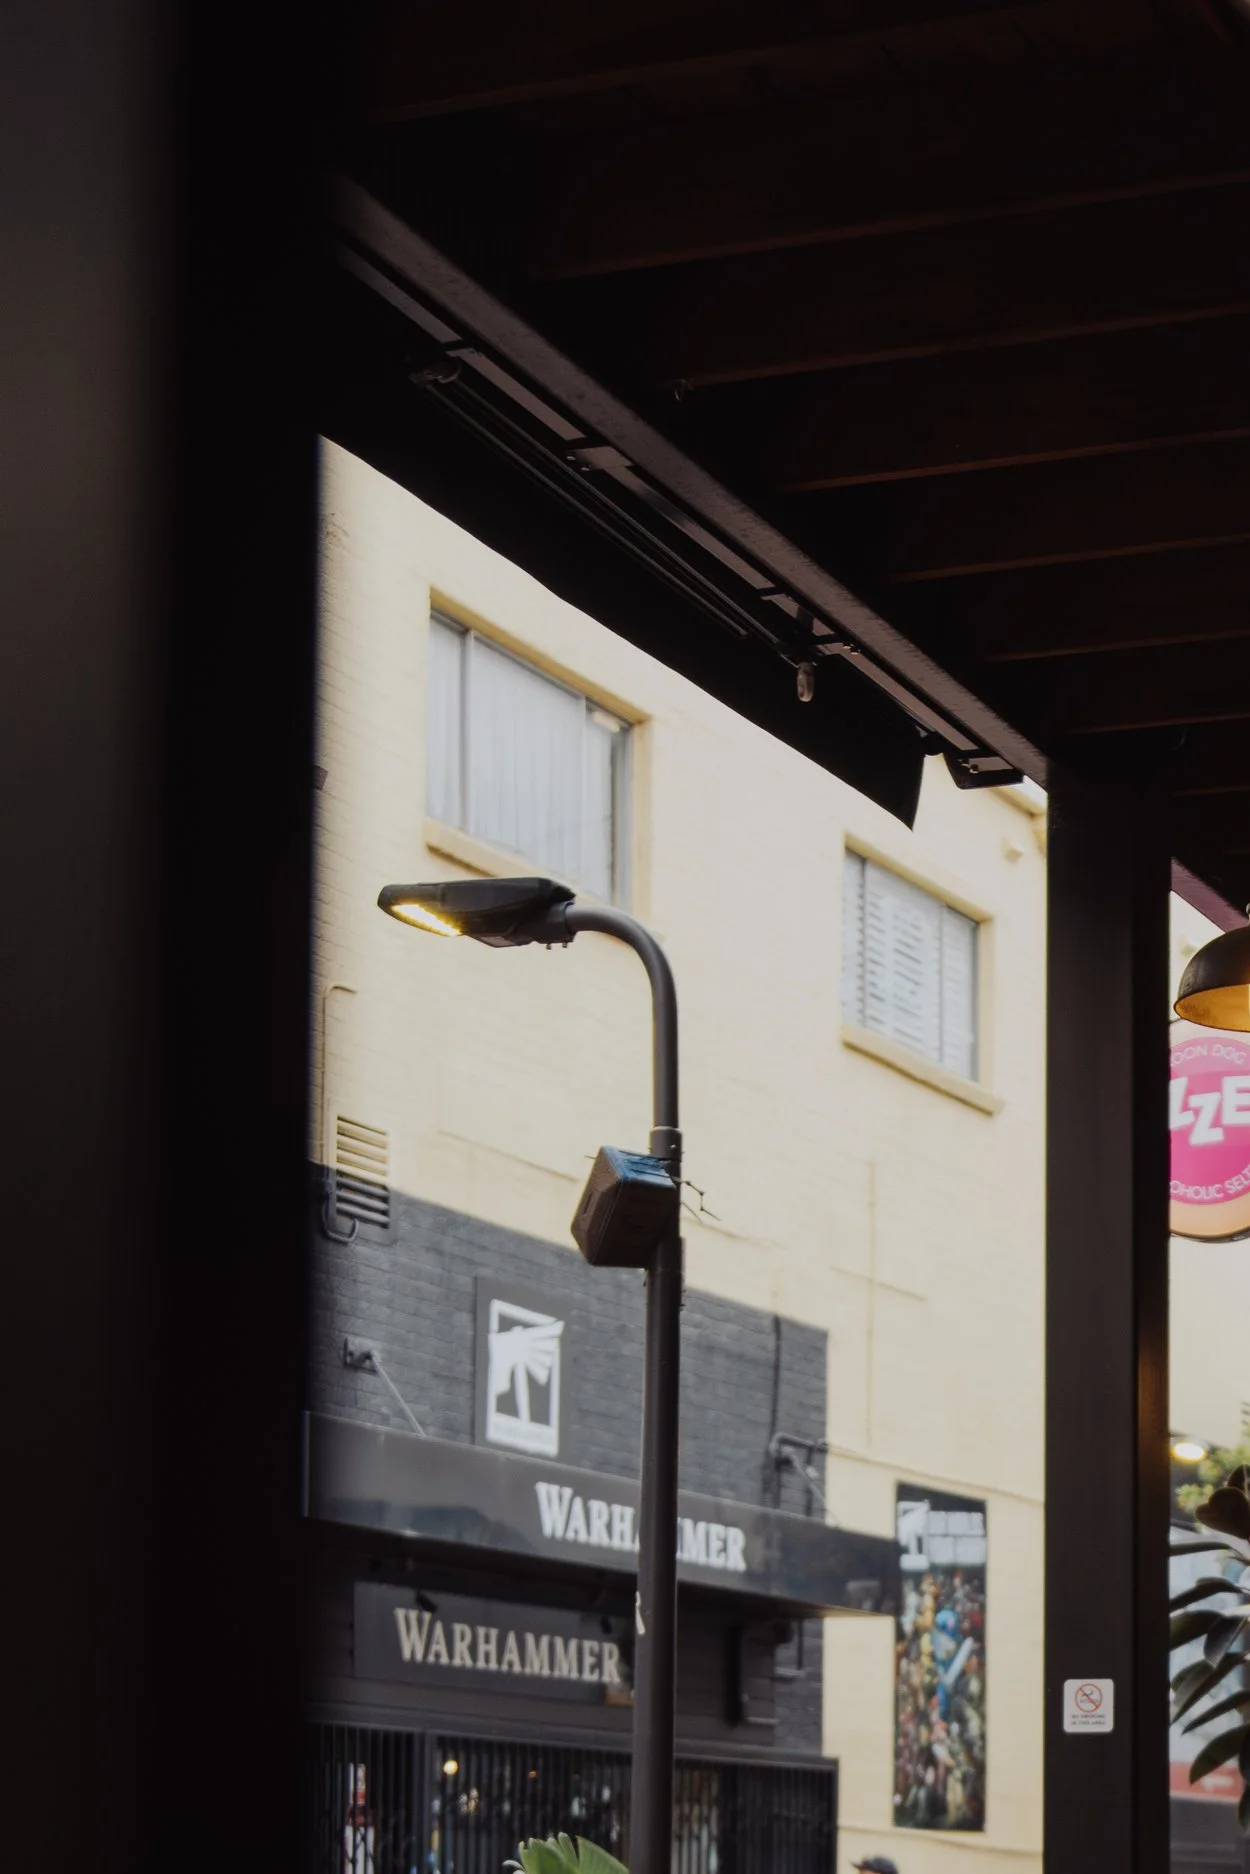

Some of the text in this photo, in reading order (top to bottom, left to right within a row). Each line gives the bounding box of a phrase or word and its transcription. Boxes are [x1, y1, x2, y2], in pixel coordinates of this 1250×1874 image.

[1171, 1044, 1248, 1067] OON DOG
[1170, 1180, 1224, 1199] OHOLIC
[535, 1481, 747, 1573] WARHMER
[394, 1607, 621, 1684] WARHAMMER
